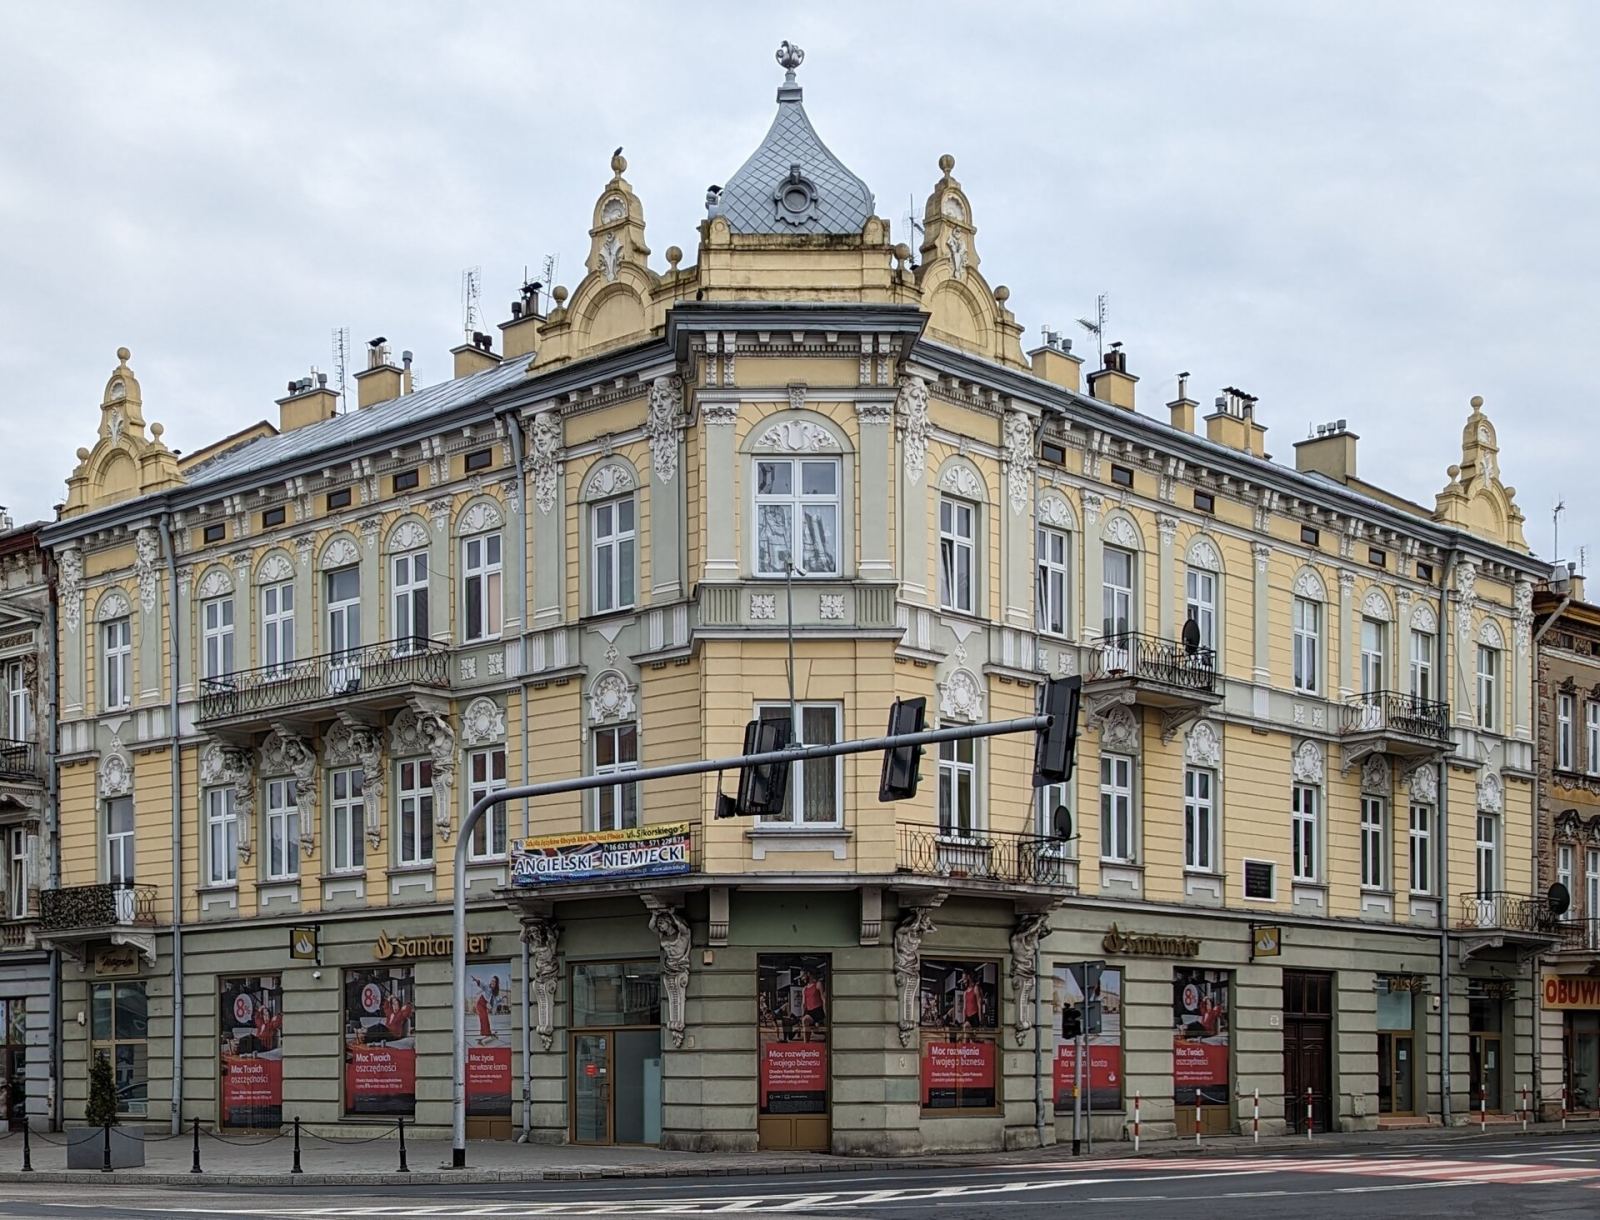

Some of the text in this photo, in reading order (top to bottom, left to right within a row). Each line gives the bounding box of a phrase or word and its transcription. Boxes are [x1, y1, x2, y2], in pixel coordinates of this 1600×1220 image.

[515, 846, 685, 874] ANGIELSKI NIEMIECKI
[356, 1052, 391, 1062] Moc Twoich
[769, 1049, 820, 1059] Moc rozwijania
[931, 1046, 980, 1058] Moc rozwijania
[1061, 1048, 1074, 1057] Moc
[1176, 1048, 1187, 1056] Moc
[769, 1059, 795, 1068] Twojego
[932, 1056, 985, 1068] Twojego biznesu
[231, 1065, 243, 1073] Moc
[356, 1062, 397, 1074] oszczędności
